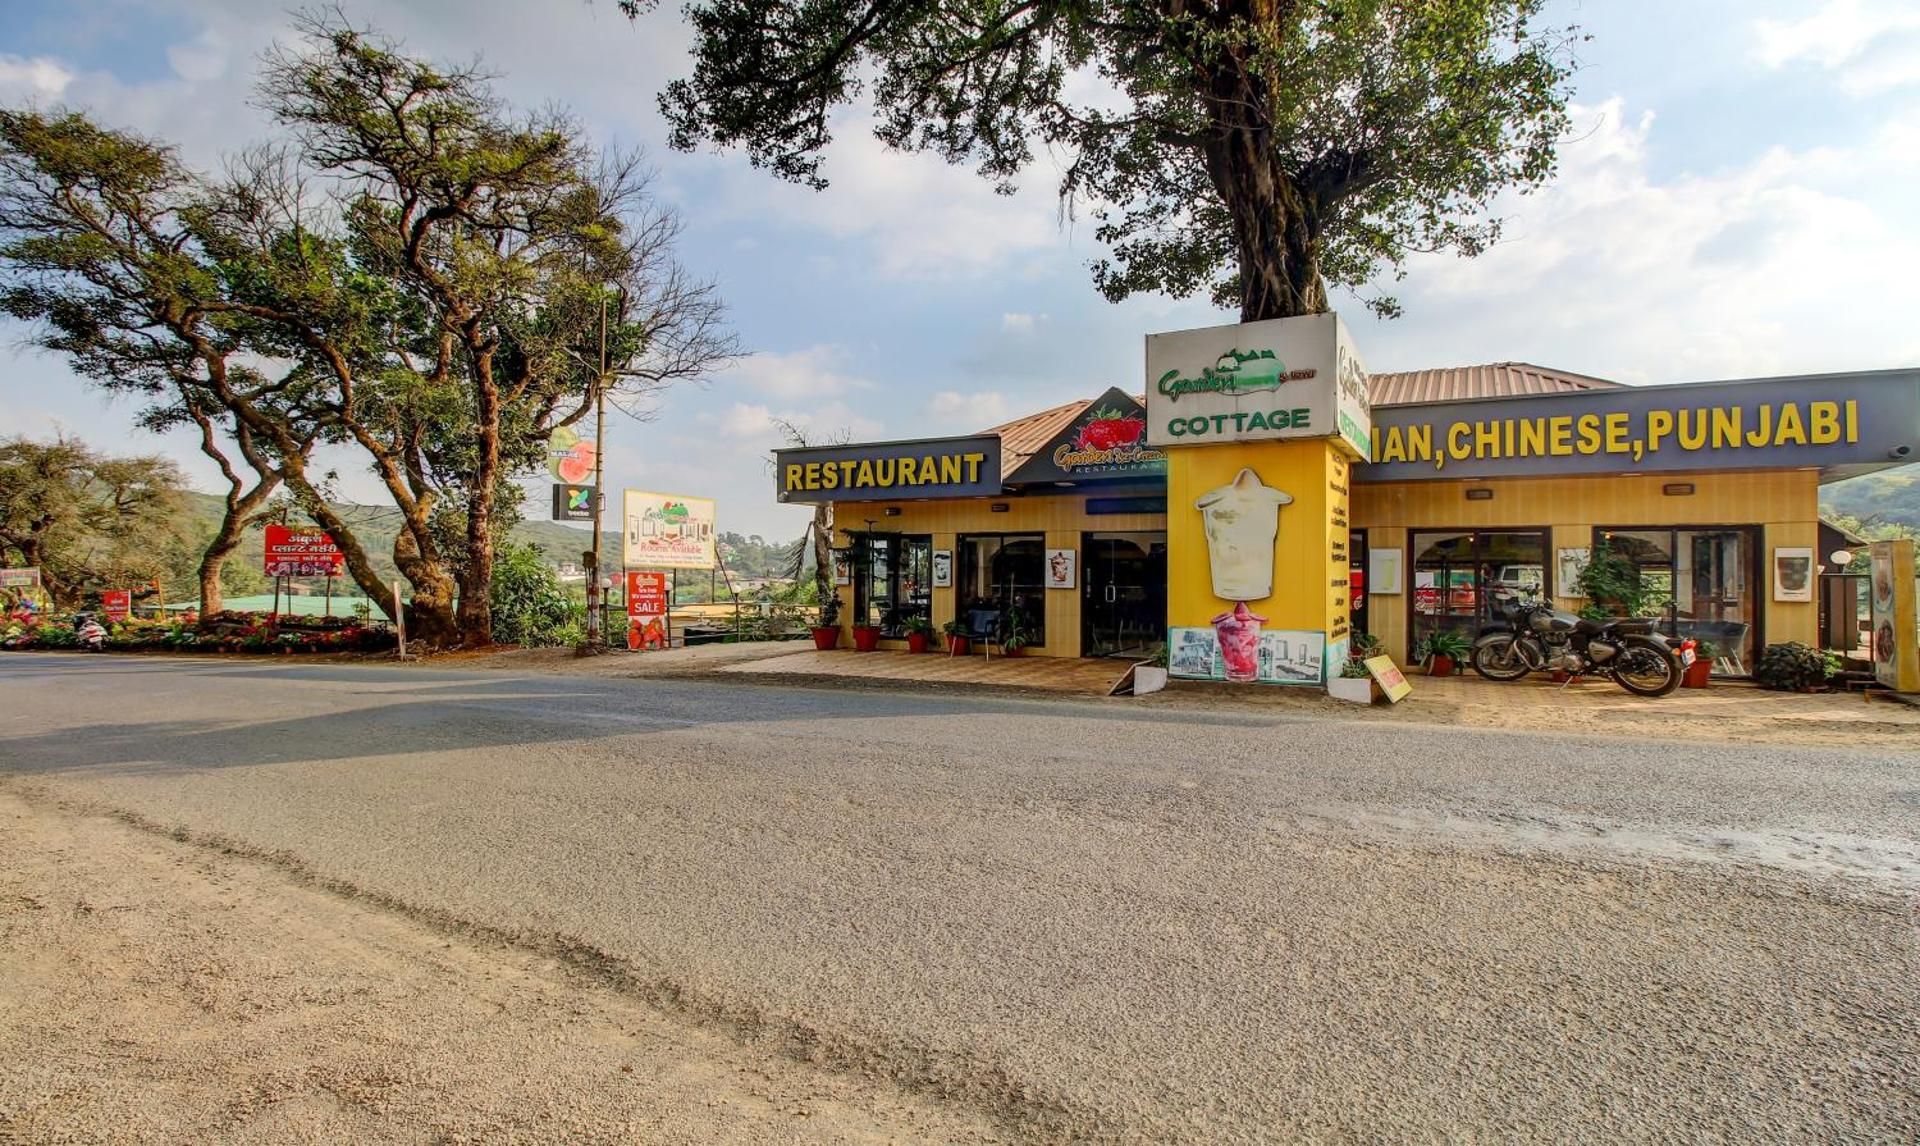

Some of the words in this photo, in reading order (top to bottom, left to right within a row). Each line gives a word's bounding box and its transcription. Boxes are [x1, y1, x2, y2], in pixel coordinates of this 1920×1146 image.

[1168, 408, 1311, 437] COTTAGE
[786, 452, 985, 492] RESTAURANT
[1053, 443, 1113, 472] Garden
[635, 602, 660, 613] SALE
